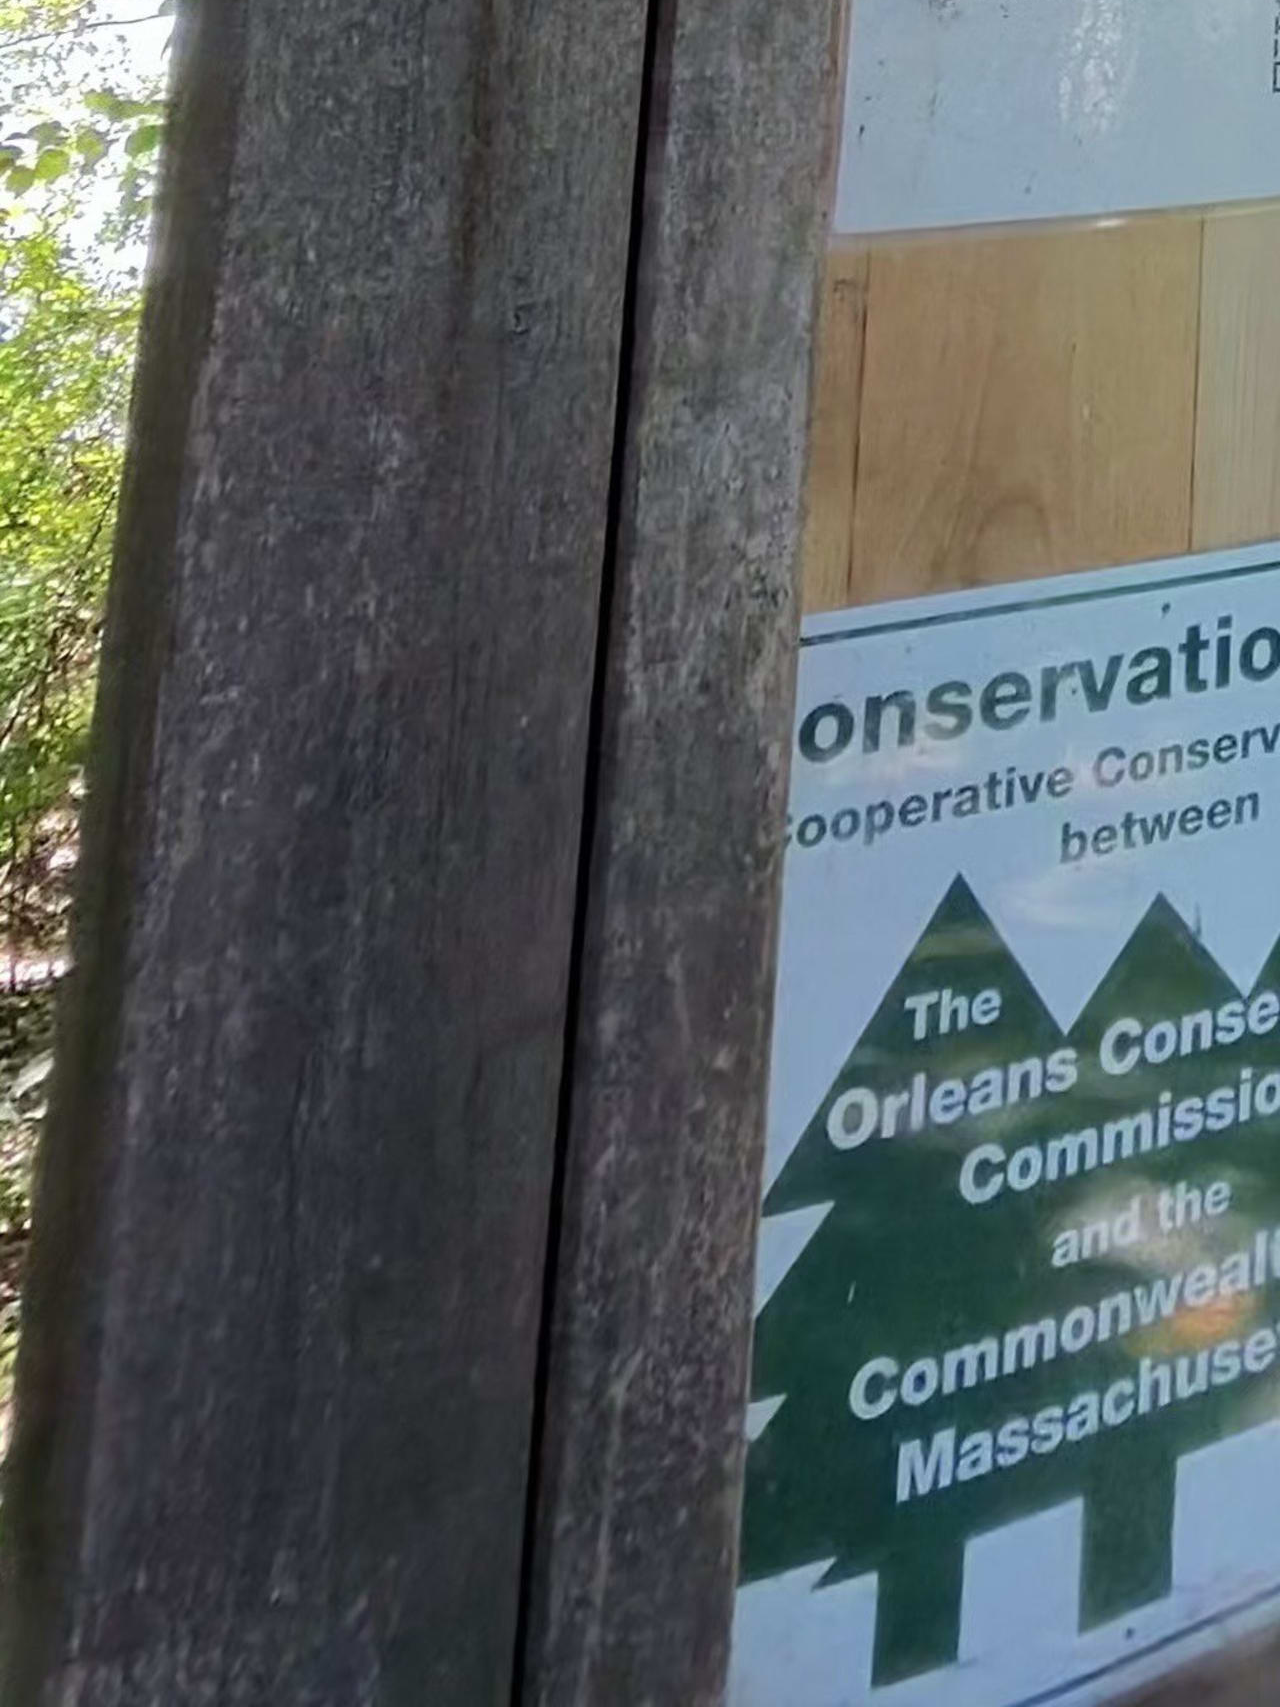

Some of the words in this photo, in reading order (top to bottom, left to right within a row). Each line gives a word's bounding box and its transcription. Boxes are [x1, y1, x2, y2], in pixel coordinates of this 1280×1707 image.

[785, 765, 1074, 848] ooperative
[1058, 786, 1261, 866] between
[904, 982, 1003, 1044] The
[826, 1042, 1079, 1153] Orleans
[1050, 1198, 1142, 1269] and
[1157, 1177, 1233, 1244] the
